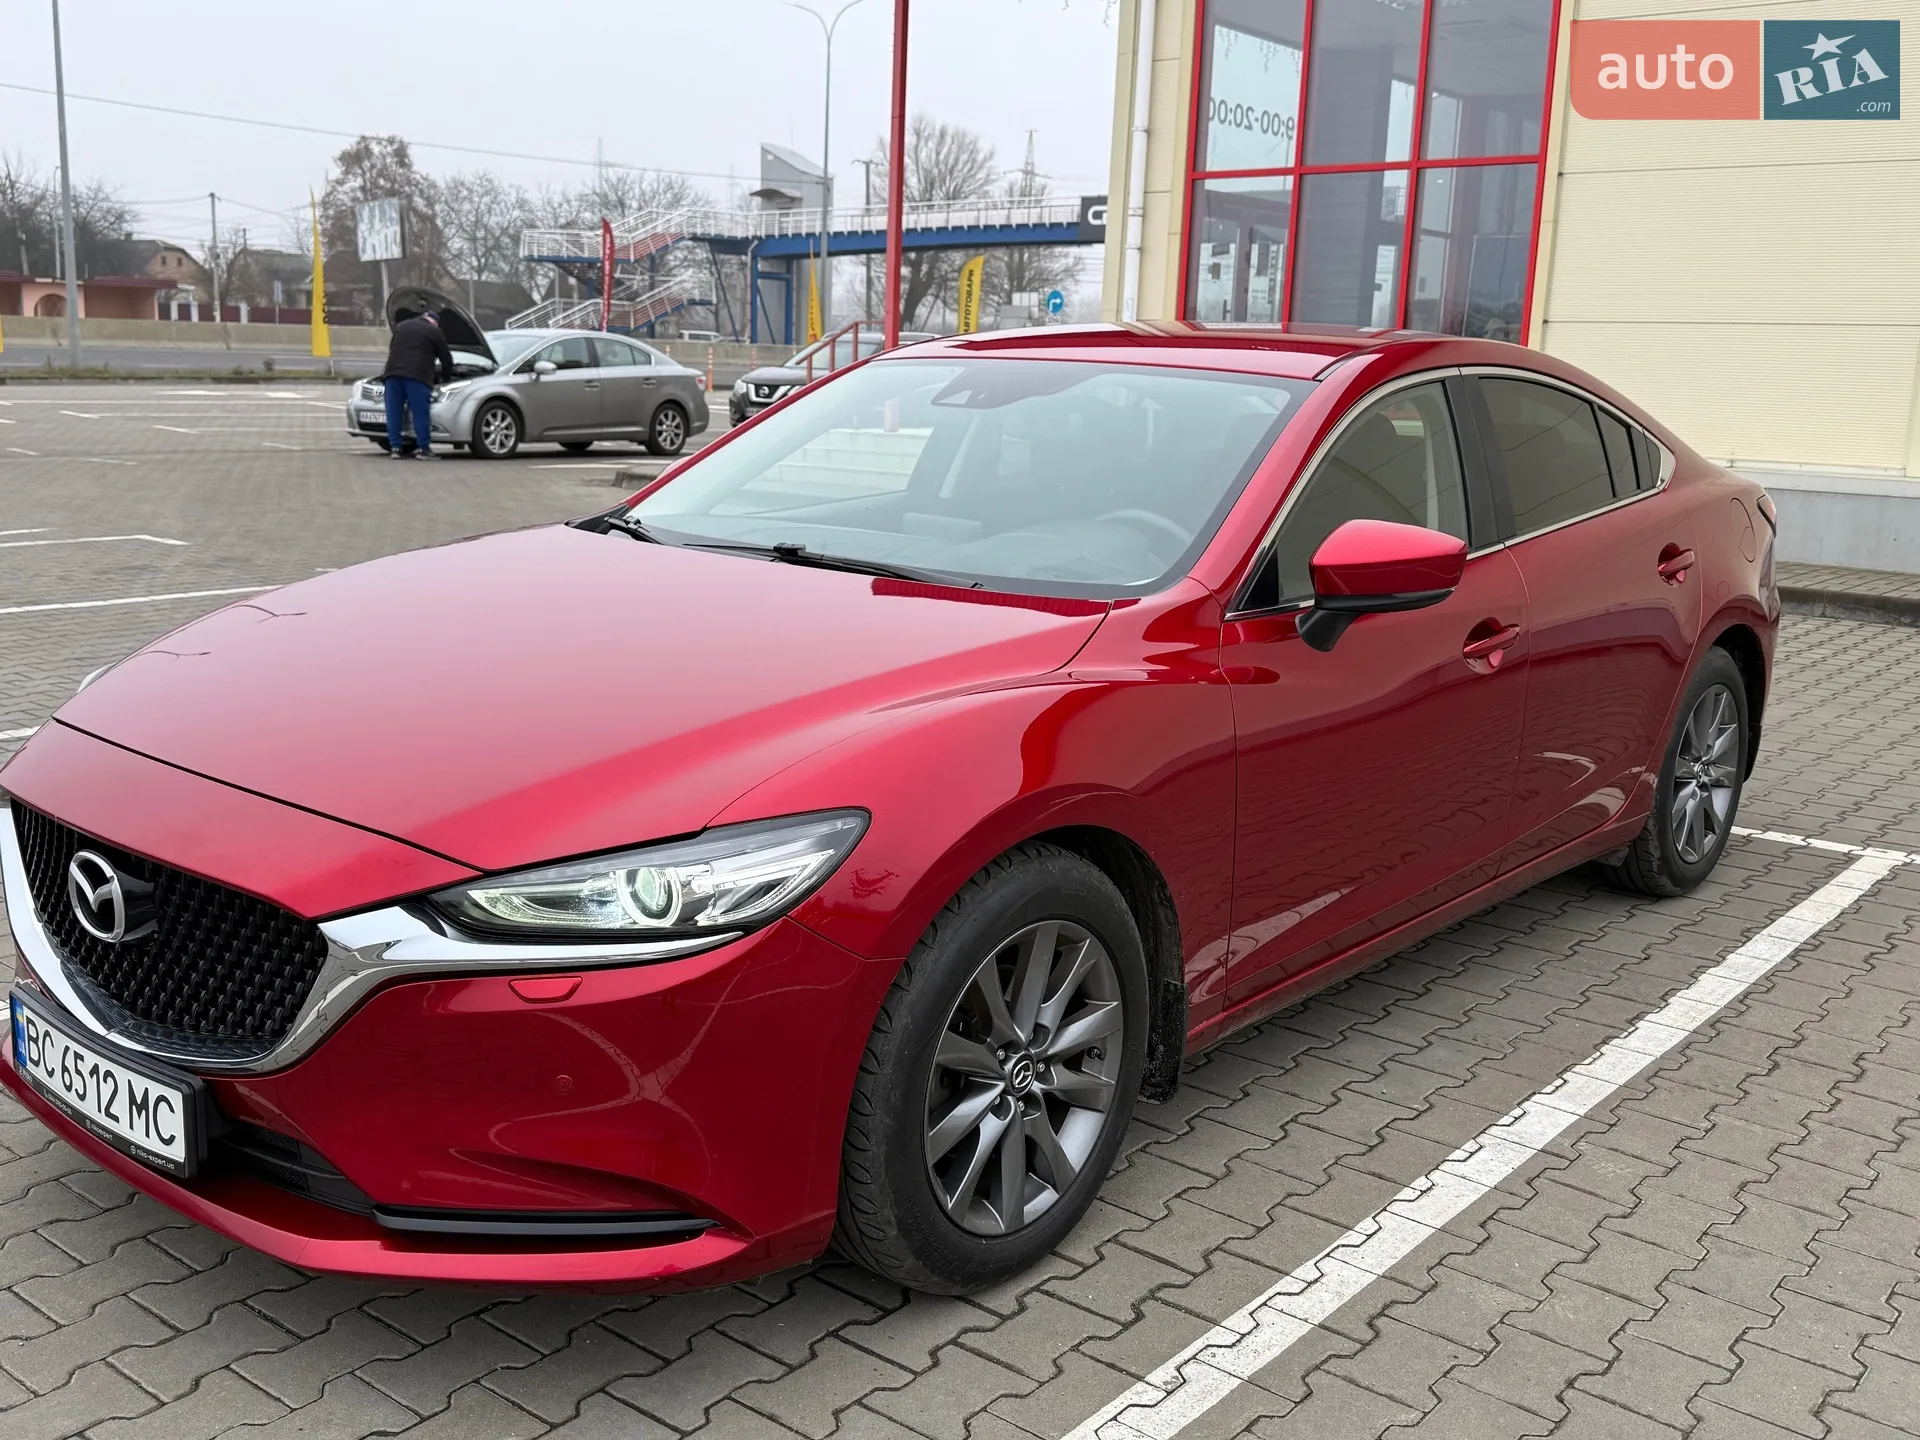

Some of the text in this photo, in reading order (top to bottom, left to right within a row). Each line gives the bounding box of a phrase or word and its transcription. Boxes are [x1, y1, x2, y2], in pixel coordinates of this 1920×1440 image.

[26, 1015, 177, 1147] BC 6512 MC
[136, 1149, 175, 1170] niko-expert.ua
